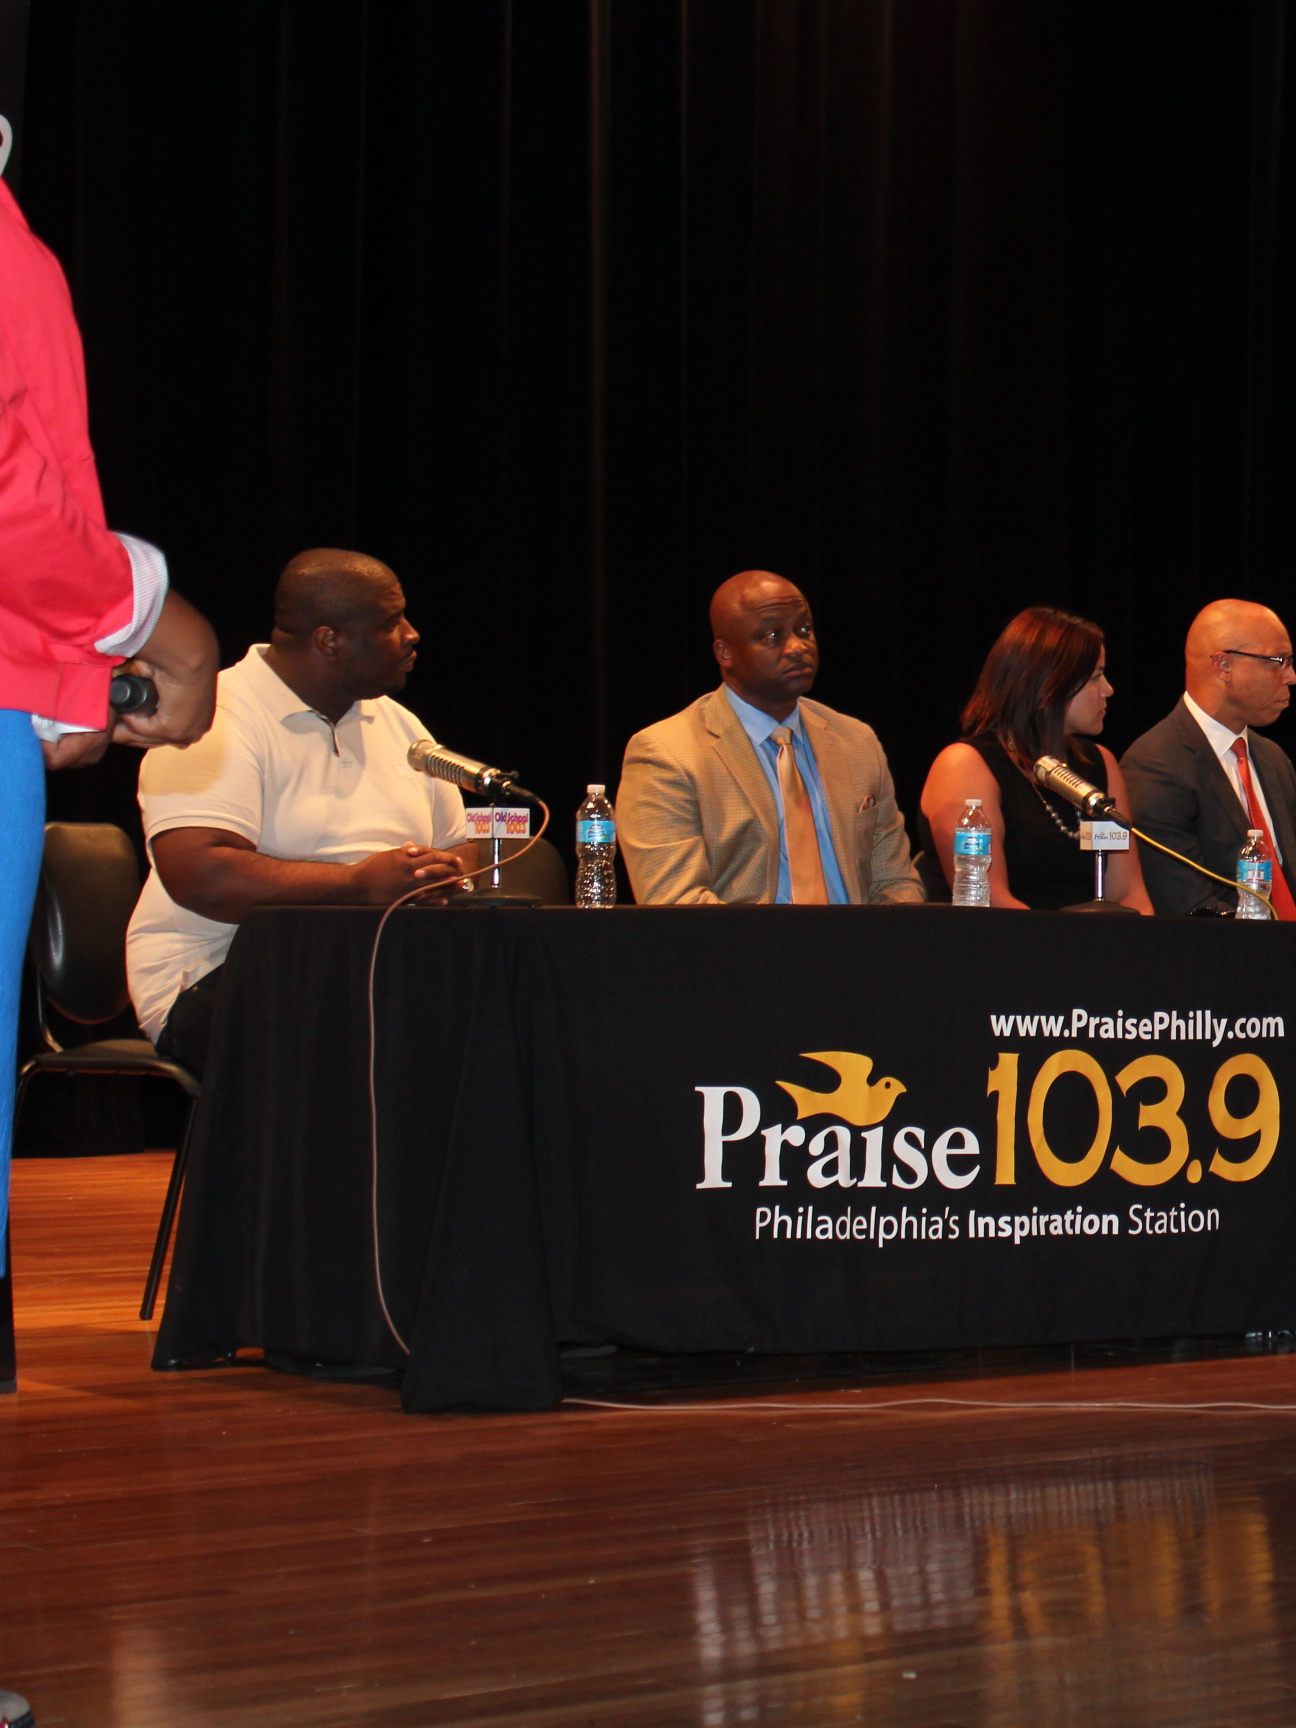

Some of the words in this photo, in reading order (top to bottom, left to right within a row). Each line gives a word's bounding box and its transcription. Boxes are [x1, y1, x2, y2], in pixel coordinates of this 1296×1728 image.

[1109, 831, 1128, 840] 103.9
[990, 1008, 1285, 1047] www.PraisePhilly.com
[695, 1086, 981, 1189] Praise
[986, 1049, 1281, 1187] 103.9
[755, 1206, 960, 1247] Philadelphia's
[968, 1206, 1119, 1244] Inspiration
[1127, 1203, 1220, 1236] Station
